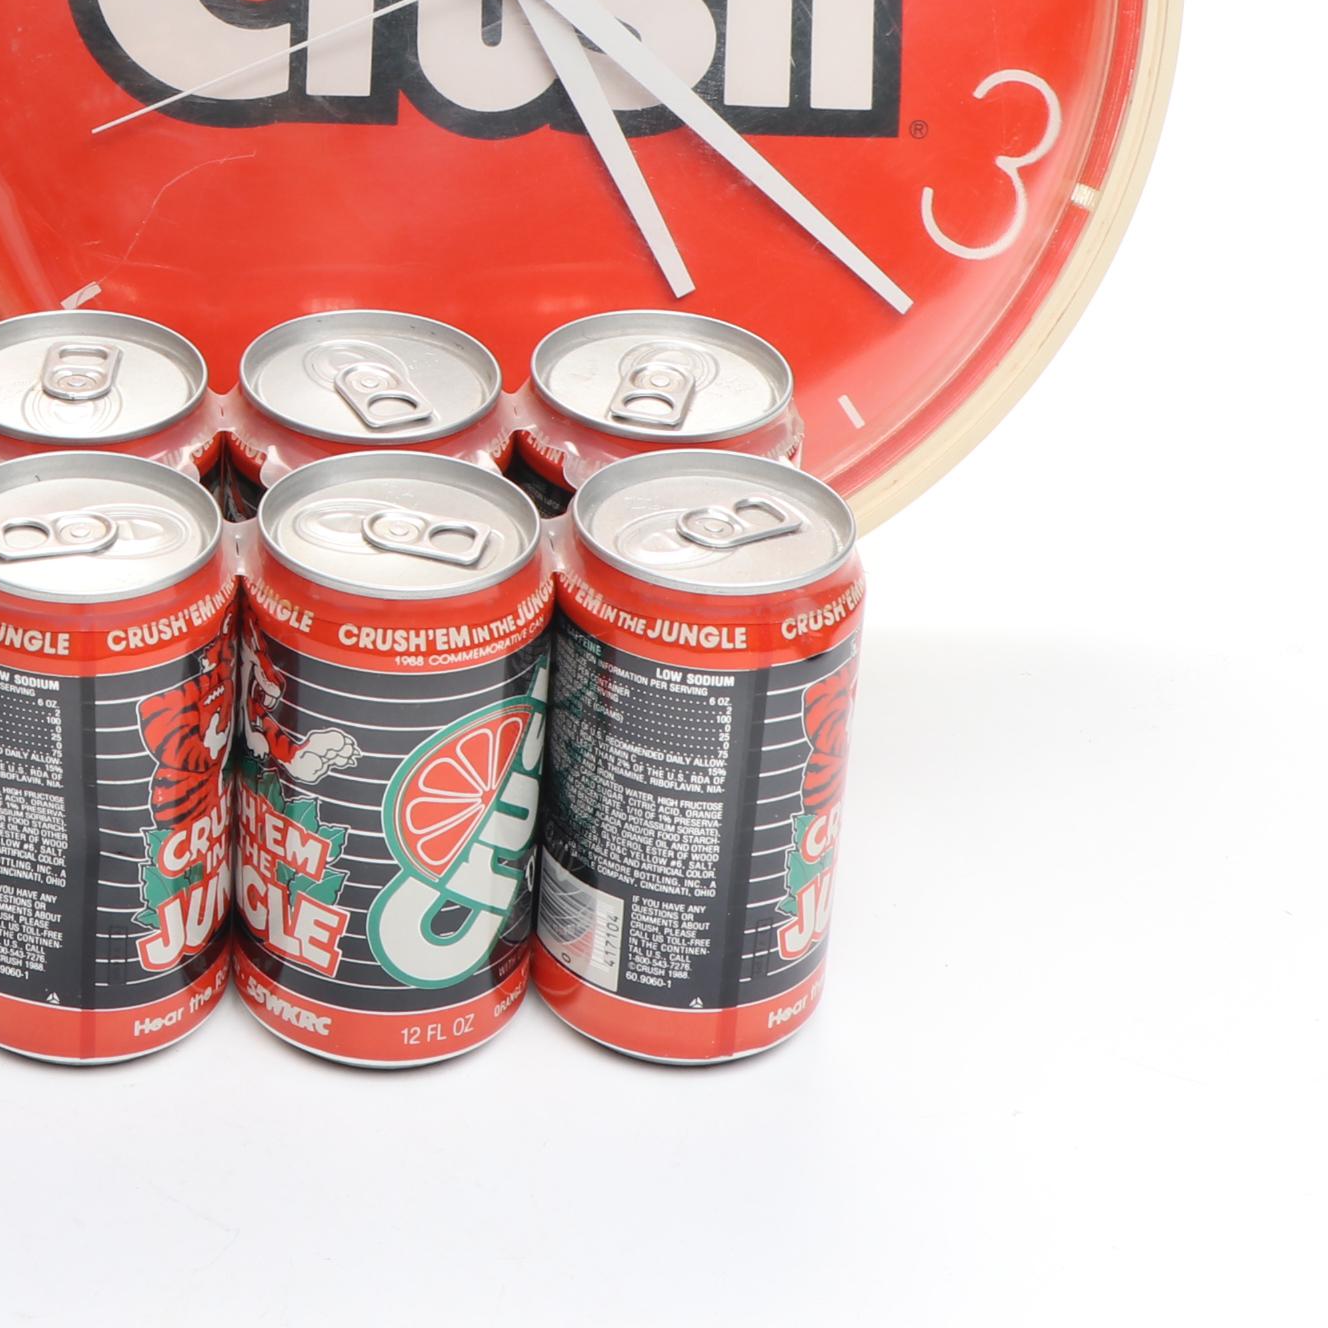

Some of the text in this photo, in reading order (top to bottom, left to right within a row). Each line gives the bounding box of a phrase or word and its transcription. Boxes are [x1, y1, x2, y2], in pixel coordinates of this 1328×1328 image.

[920, 68, 1062, 262] 3
[251, 578, 315, 633] JUNGLE
[107, 594, 214, 651] CRUSH'EM
[600, 604, 747, 649] IN THE JUNGLE
[339, 623, 471, 652] CRUSH'EM
[474, 624, 489, 644] IN
[490, 615, 515, 636] THE
[395, 617, 544, 666] 1988 COMMEMORATIVE CAN
[14, 674, 60, 691] SODIUM
[656, 668, 735, 687] LOW SODIUM
[0, 683, 35, 697] SERVING
[670, 683, 708, 696] SERVING
[666, 754, 691, 766] DAILY
[647, 767, 710, 784] THE RDA
[24, 790, 64, 802] FRUCTOSE
[31, 798, 64, 811] ORANGE
[680, 800, 724, 810] FRUCTOSE
[628, 798, 722, 820] CITRIC ORANGE
[624, 823, 680, 841] AND/OR FOOD
[628, 815, 674, 832] POTASSIUM
[0, 830, 26, 841] ESTER
[41, 837, 67, 849] WOOD
[41, 829, 67, 841] OTHER
[621, 830, 720, 852] ORANGE OTHER
[630, 850, 668, 865] YELLOW
[646, 845, 719, 862] ESTER WOOD
[634, 869, 680, 887] BOTTLING,
[641, 861, 684, 877] ARTIFICIAL
[46, 876, 65, 887] OHIO
[597, 865, 716, 897] COMPANY, CINCINNATI, OHIO
[16, 887, 38, 900] HAVE
[40, 893, 57, 903] ANY
[633, 895, 706, 913] IF YOU HAVE ANY
[34, 901, 46, 910] OR
[632, 904, 694, 921] QUESTIONS OR
[19, 916, 49, 929] PLEASE
[34, 910, 61, 922] ABOUT
[631, 912, 710, 930] COMMENTS ABOUT
[9, 922, 19, 931] US
[22, 925, 63, 941] TOLL-FREE
[630, 920, 696, 938] CRUSH, PLEASE
[630, 929, 711, 947] CALL US TOLL-FREE
[17, 933, 62, 948] CONTINEN-
[25, 943, 45, 954] CALL
[604, 915, 619, 967] 417104
[629, 937, 710, 955] IN THE CONTINEN-
[629, 945, 691, 963] TAL CALL
[625, 971, 672, 988] 60.9060-1
[134, 987, 212, 1035] Hear the
[768, 995, 808, 1030] Hear
[401, 1014, 475, 1046] 12 FL OZ
